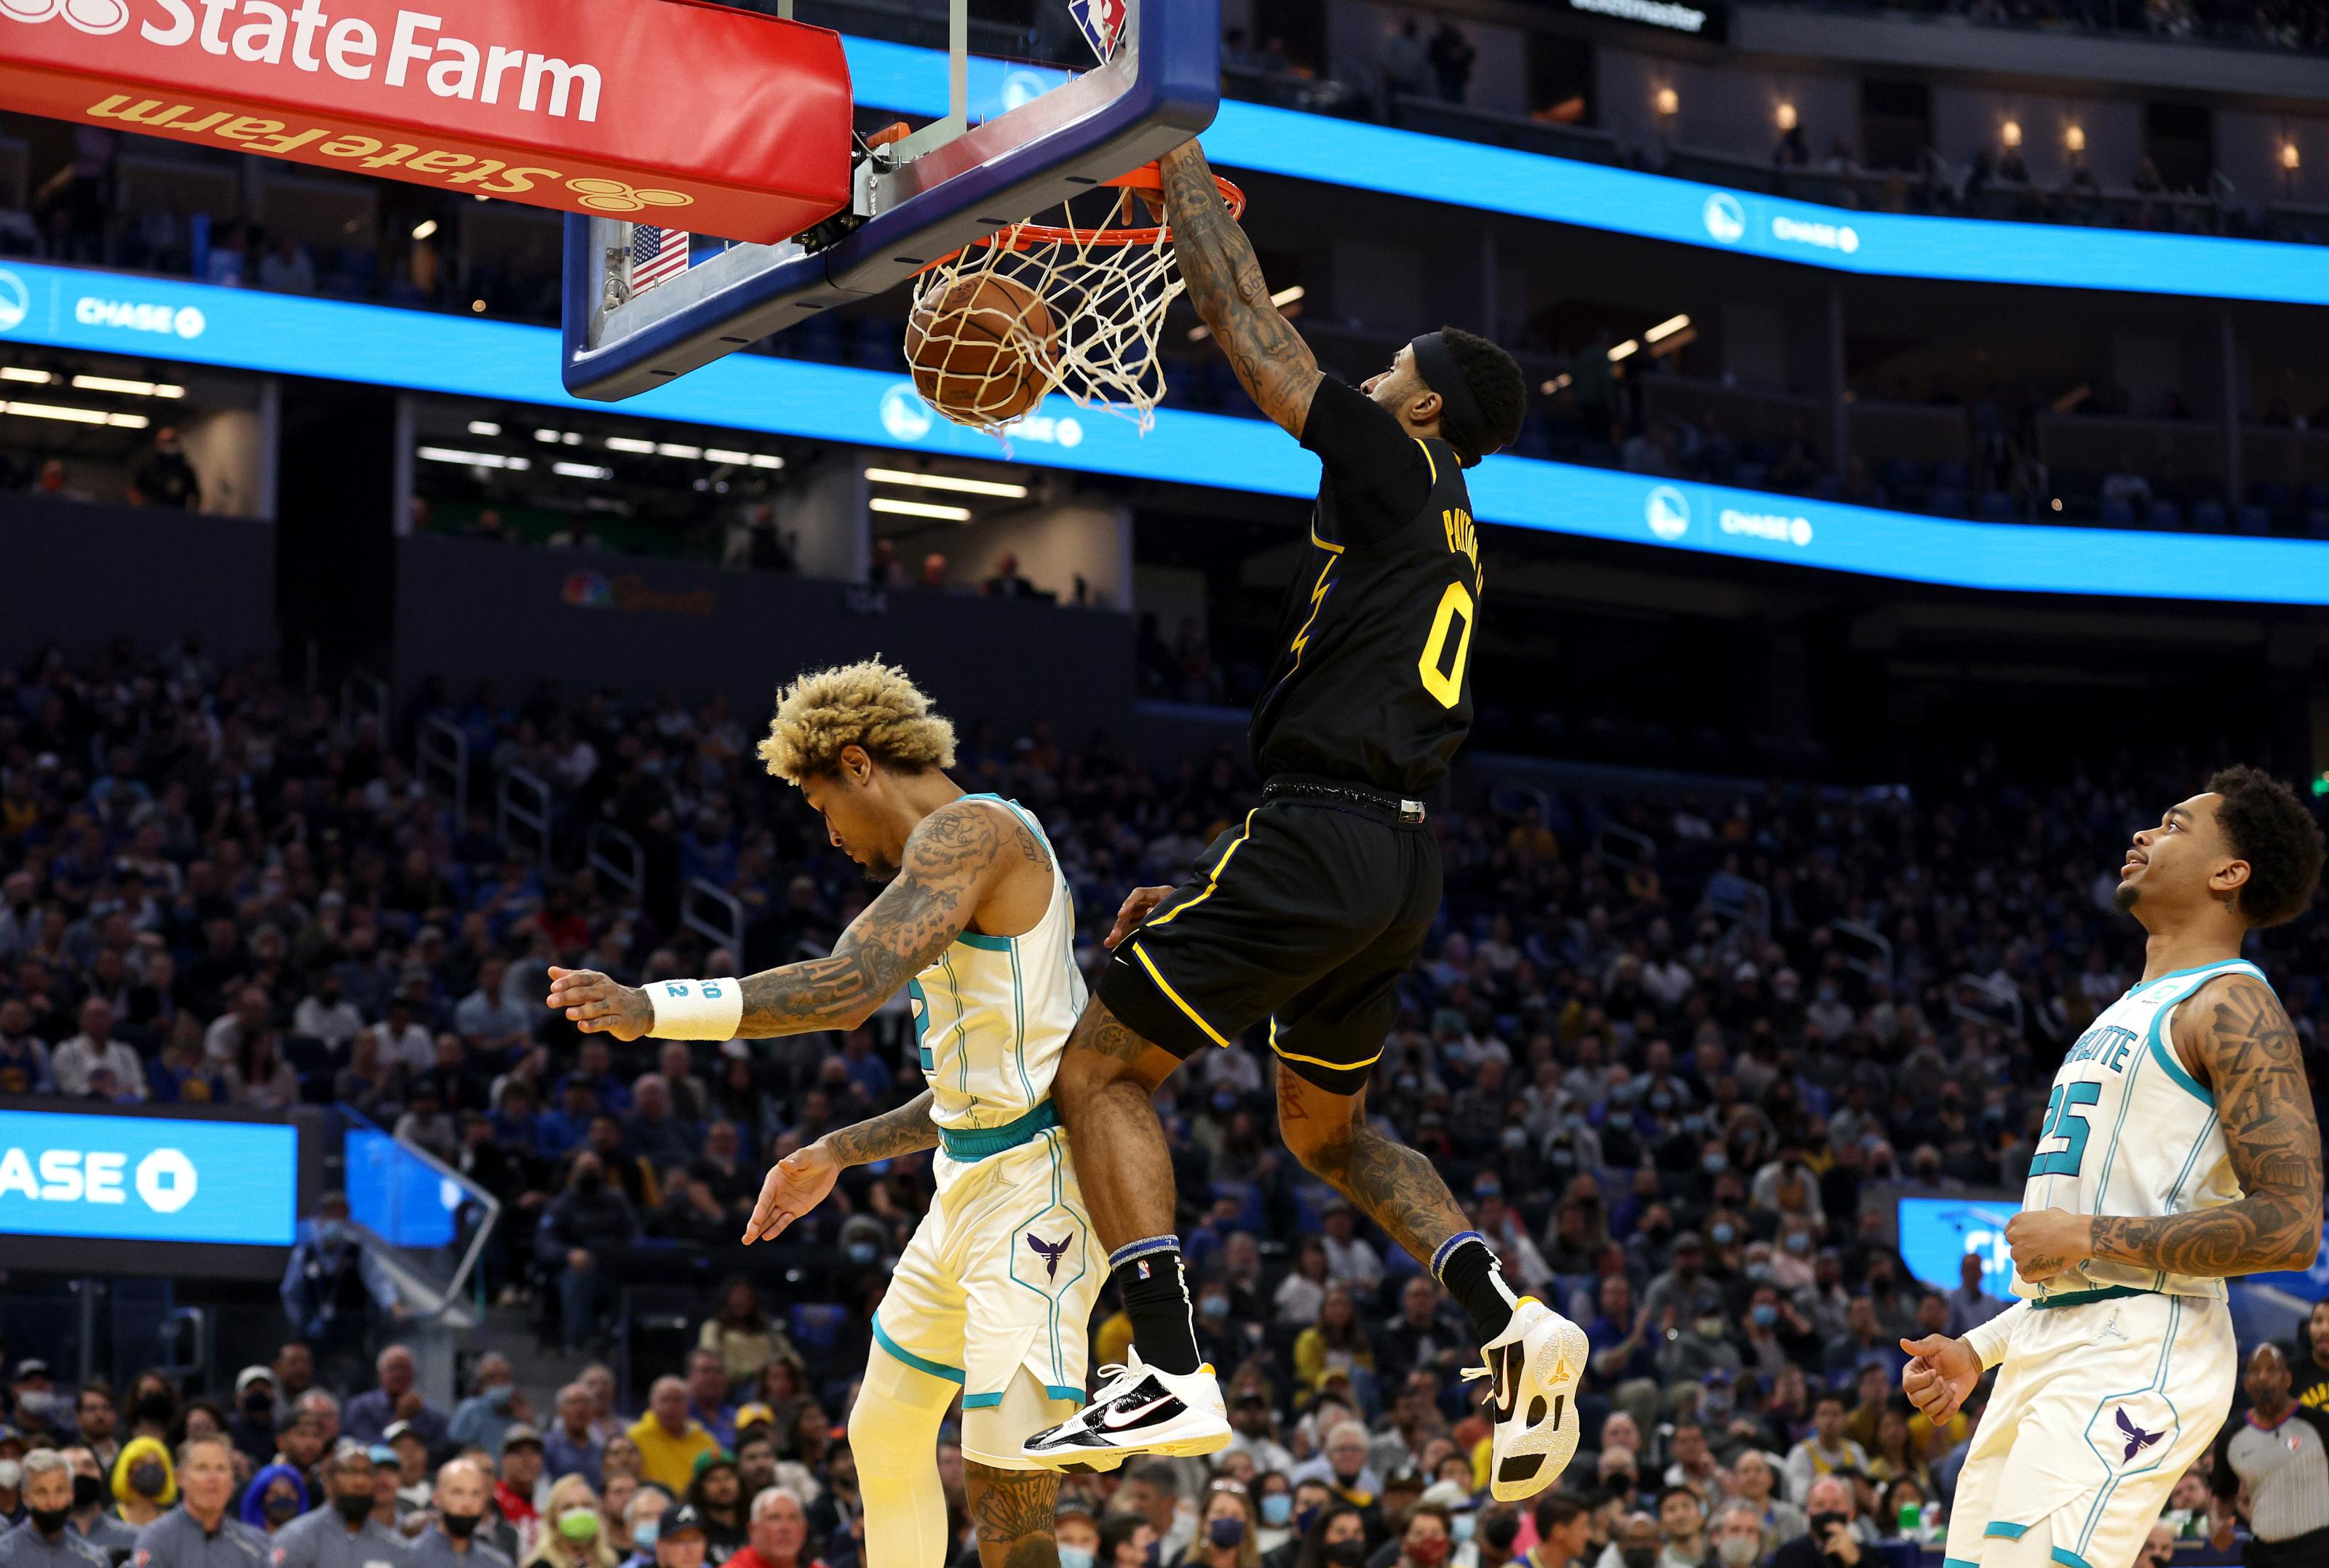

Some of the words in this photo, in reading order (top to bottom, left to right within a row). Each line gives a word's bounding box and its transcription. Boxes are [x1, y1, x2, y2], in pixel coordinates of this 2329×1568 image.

[76, 297, 175, 334] CHASE
[1720, 509, 1788, 541] CHASE
[1418, 581, 1474, 709] 0
[2028, 1081, 2101, 1177] 25
